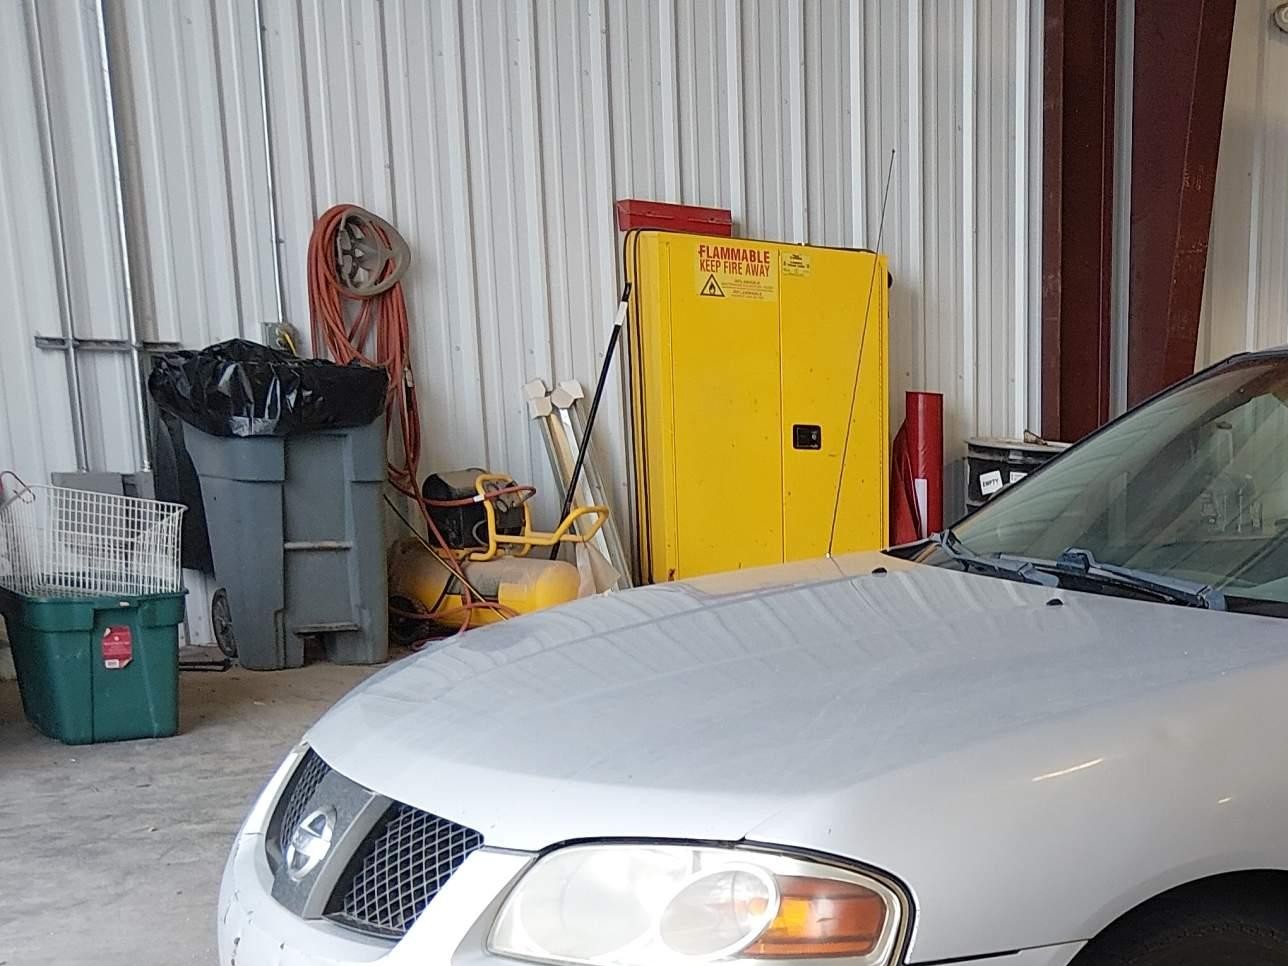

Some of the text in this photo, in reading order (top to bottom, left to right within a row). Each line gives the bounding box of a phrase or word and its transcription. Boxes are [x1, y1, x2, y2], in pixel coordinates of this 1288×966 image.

[699, 245, 770, 263] FLAMMABLE
[700, 260, 720, 273] KEEP
[724, 260, 742, 275] FIRE
[745, 262, 770, 277] AWAY
